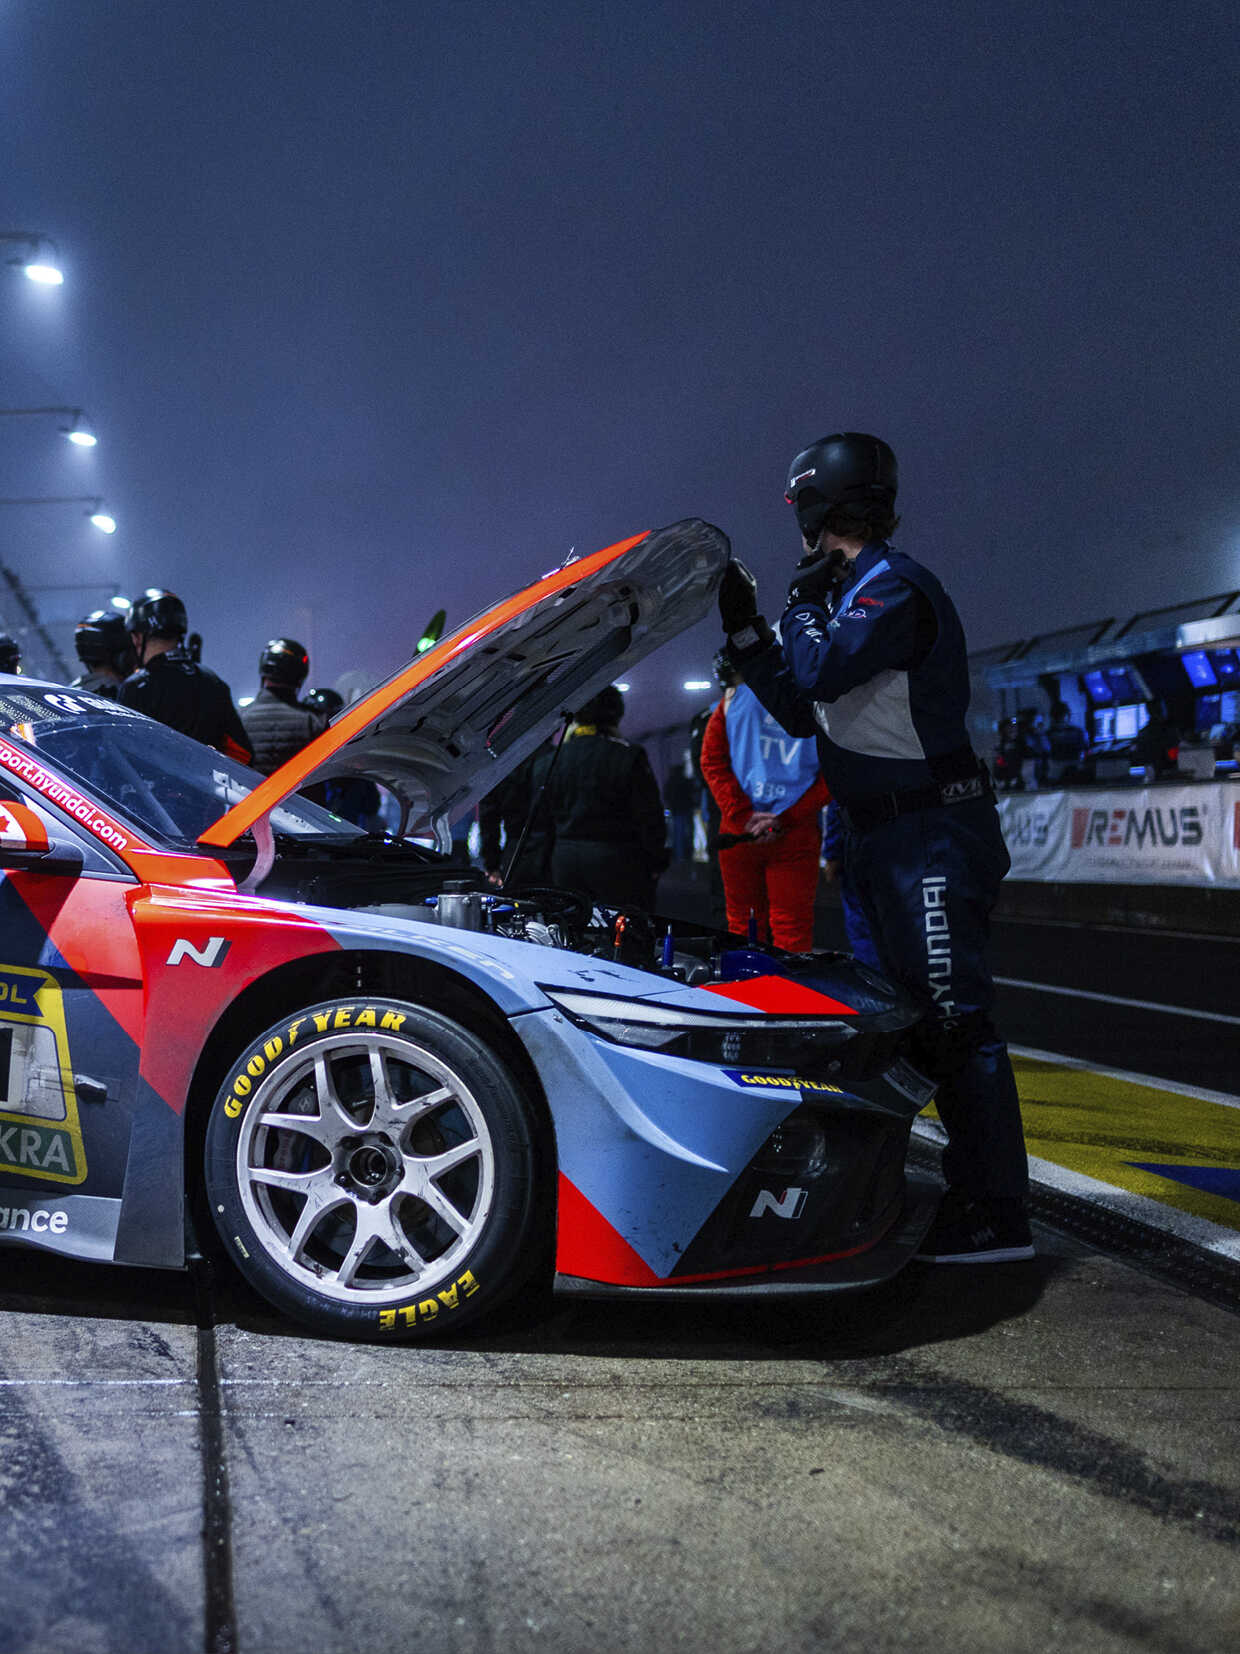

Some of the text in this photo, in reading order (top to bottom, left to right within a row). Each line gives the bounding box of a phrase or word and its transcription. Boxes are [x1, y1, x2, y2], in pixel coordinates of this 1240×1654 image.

[760, 736, 801, 765] TV
[1086, 806, 1204, 851] REMUS
[922, 876, 962, 1017] HYUNDAI
[223, 1005, 408, 1119] GOODYEAR
[741, 1074, 844, 1094] GOODYEAR
[378, 1269, 481, 1332] EAGLE
